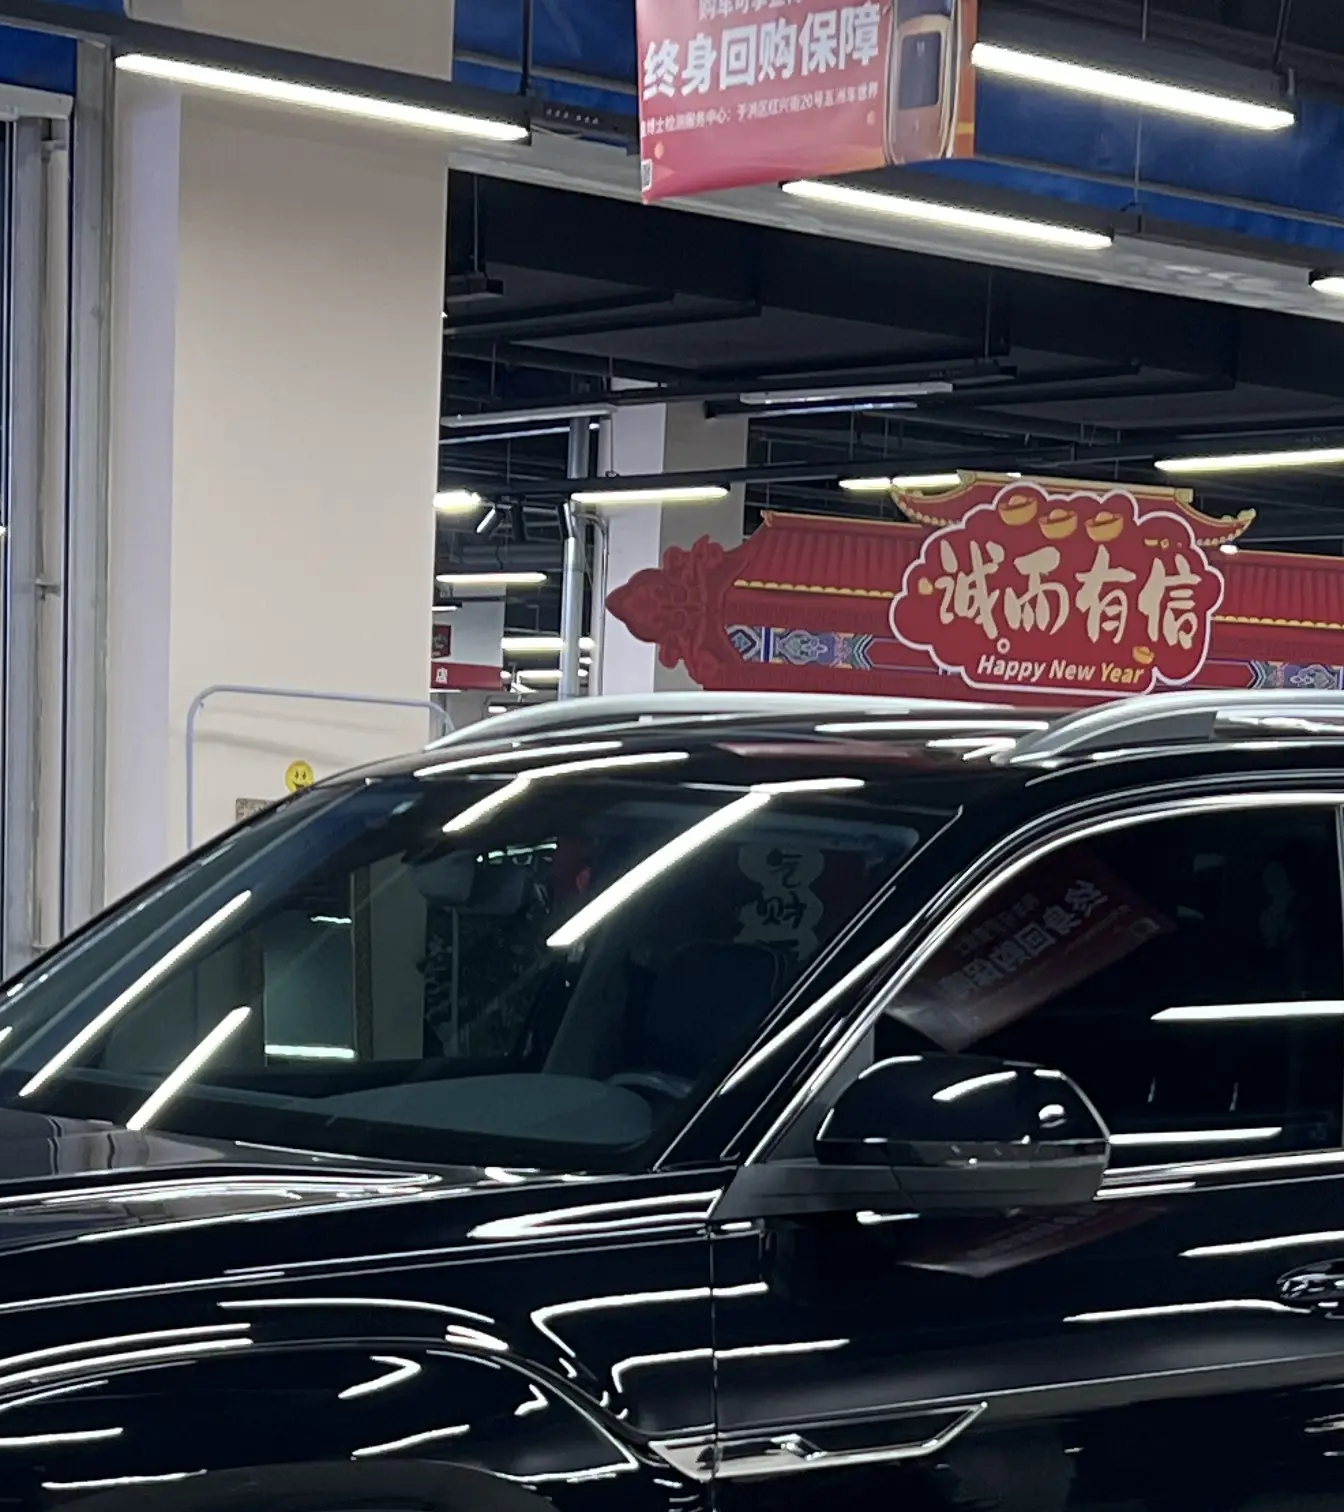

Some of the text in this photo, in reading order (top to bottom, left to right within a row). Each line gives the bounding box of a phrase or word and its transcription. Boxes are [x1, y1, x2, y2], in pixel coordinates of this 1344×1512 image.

[642, 1, 881, 100] 终身回购保障
[977, 654, 1144, 684] Happy New Year
